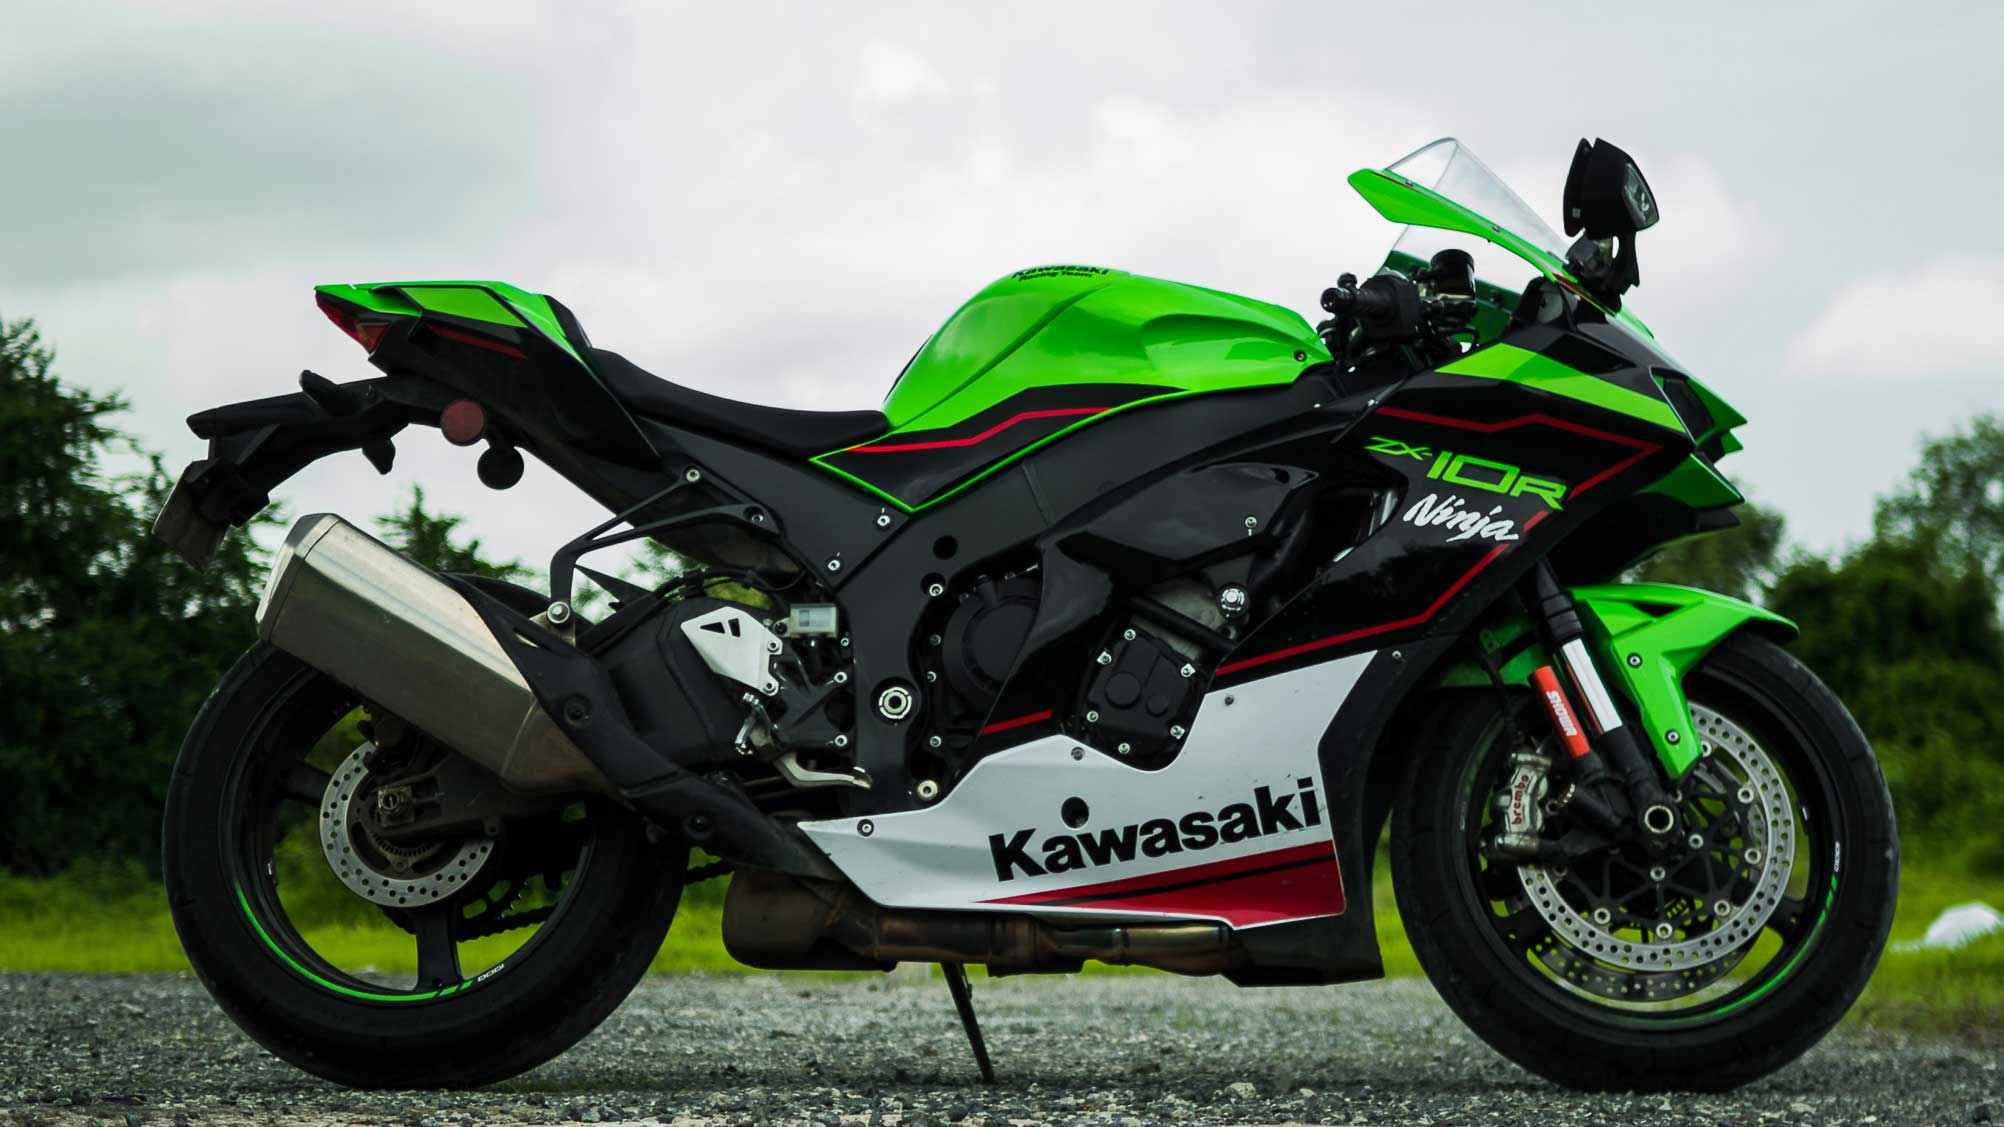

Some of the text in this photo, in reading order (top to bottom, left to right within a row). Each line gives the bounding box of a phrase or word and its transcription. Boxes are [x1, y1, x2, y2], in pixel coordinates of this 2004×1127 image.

[1012, 265, 1109, 279] Kawasaki
[1364, 437, 1566, 511] ZX-10R
[1403, 493, 1519, 542] Ninja
[1511, 775, 1529, 825] brembo
[988, 776, 1321, 881] Kawasaki
